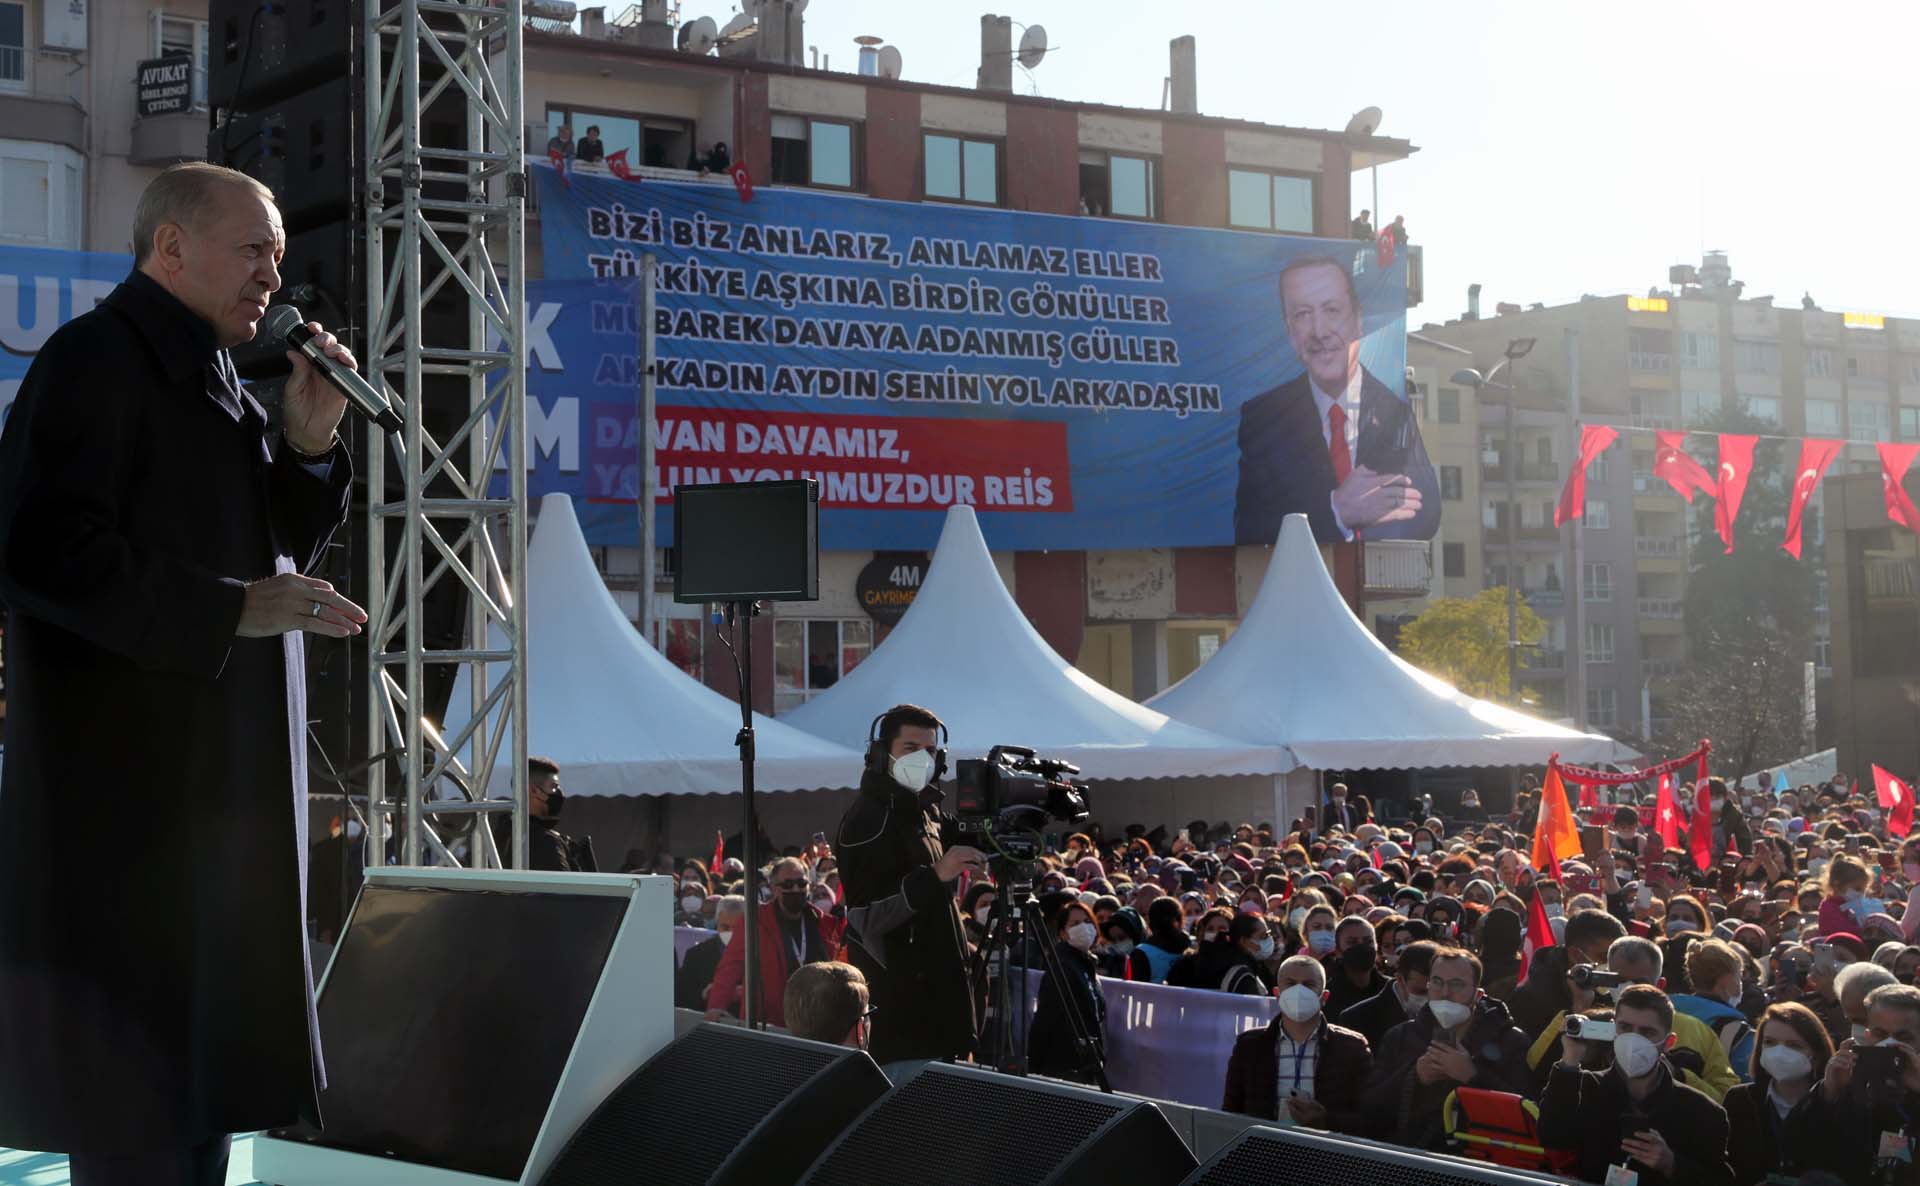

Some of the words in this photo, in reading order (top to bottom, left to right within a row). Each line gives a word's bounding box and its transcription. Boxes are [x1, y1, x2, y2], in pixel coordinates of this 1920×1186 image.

[141, 63, 189, 86] AVUKAT
[587, 202, 662, 246] BİZİ
[671, 209, 731, 251] BİZ
[739, 226, 903, 267] ANLARIZ,
[909, 237, 1069, 276] ANLAMAZ
[1075, 250, 1163, 282] ELLER
[754, 270, 885, 310] AŞKINA
[890, 275, 1003, 316] BİRDİR
[1009, 281, 1171, 325] GÖNÜLLER
[773, 316, 911, 353] DAVAYA
[917, 325, 1063, 367] ADANMIŞ
[1070, 328, 1181, 367] GÜLLER
[771, 365, 877, 399] AYDIN
[884, 364, 981, 403] SENİN
[1049, 377, 1222, 418] ARKADAŞIN
[736, 422, 910, 464] DAVAMIZ,
[984, 467, 1054, 506] REİS
[889, 565, 920, 587] 4M
